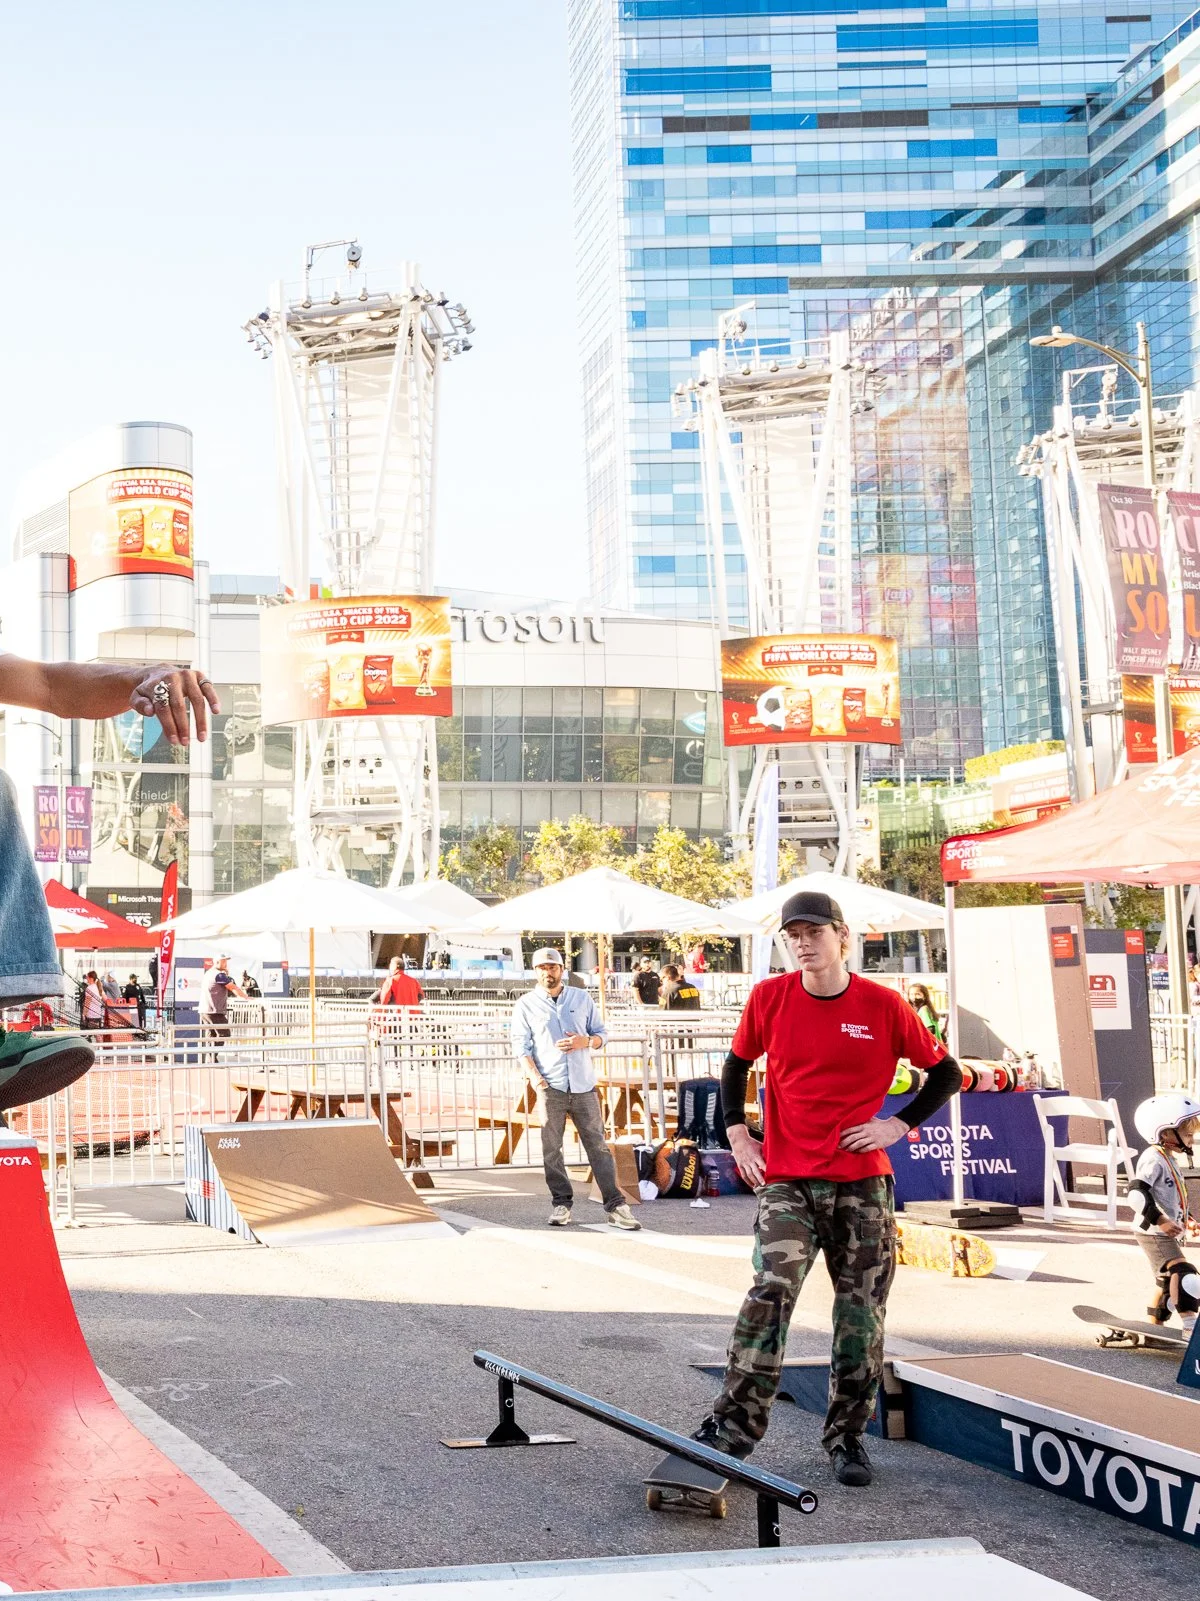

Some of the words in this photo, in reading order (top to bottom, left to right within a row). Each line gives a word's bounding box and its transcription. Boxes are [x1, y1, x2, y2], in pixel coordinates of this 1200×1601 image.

[127, 486, 161, 495] WORLD
[163, 487, 179, 496] CUP
[1111, 496, 1123, 504] Oct
[1114, 509, 1158, 549] RO
[1182, 557, 1195, 566] The
[1121, 552, 1158, 586] MY
[343, 607, 373, 616] SNACKS
[374, 606, 384, 614] OF
[386, 606, 400, 614] THE
[1126, 590, 1168, 634] SO
[308, 617, 346, 628] WORLD
[350, 615, 373, 626] CUP
[375, 614, 408, 625] 2022
[764, 652, 788, 662] FIFA
[790, 652, 828, 661] WORLD
[830, 651, 850, 661] CUP
[851, 652, 876, 661] 2022
[1123, 647, 1139, 655] WALT
[39, 795, 58, 812] RO
[67, 797, 85, 813] CK
[39, 813, 57, 827] MY
[40, 828, 60, 846] SO
[67, 830, 85, 848] UL
[946, 847, 983, 860] SPORTS
[118, 895, 146, 903] Microsoft
[847, 1023, 868, 1031] TOYOTA
[909, 1143, 972, 1160] SPORS
[680, 1153, 697, 1190] Wilson
